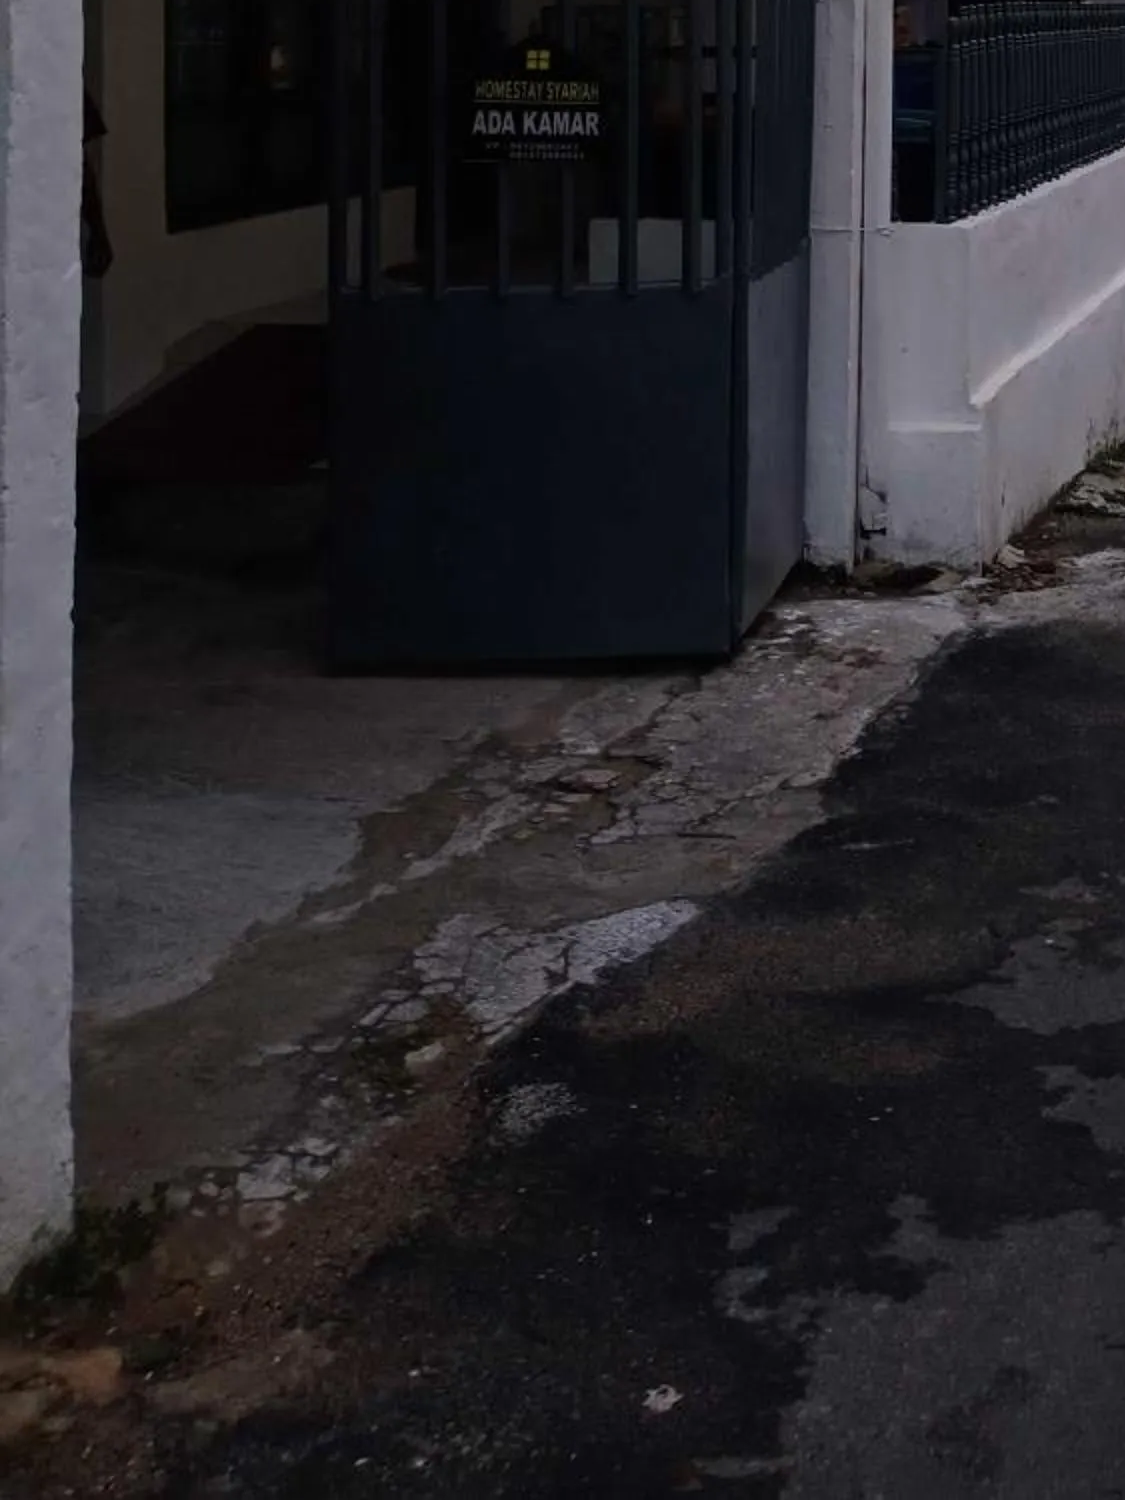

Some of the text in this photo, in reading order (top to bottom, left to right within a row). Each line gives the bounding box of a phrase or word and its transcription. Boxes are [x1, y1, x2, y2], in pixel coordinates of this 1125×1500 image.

[474, 80, 541, 100] HOMESTAY
[473, 109, 600, 137] ADA KAMAR
